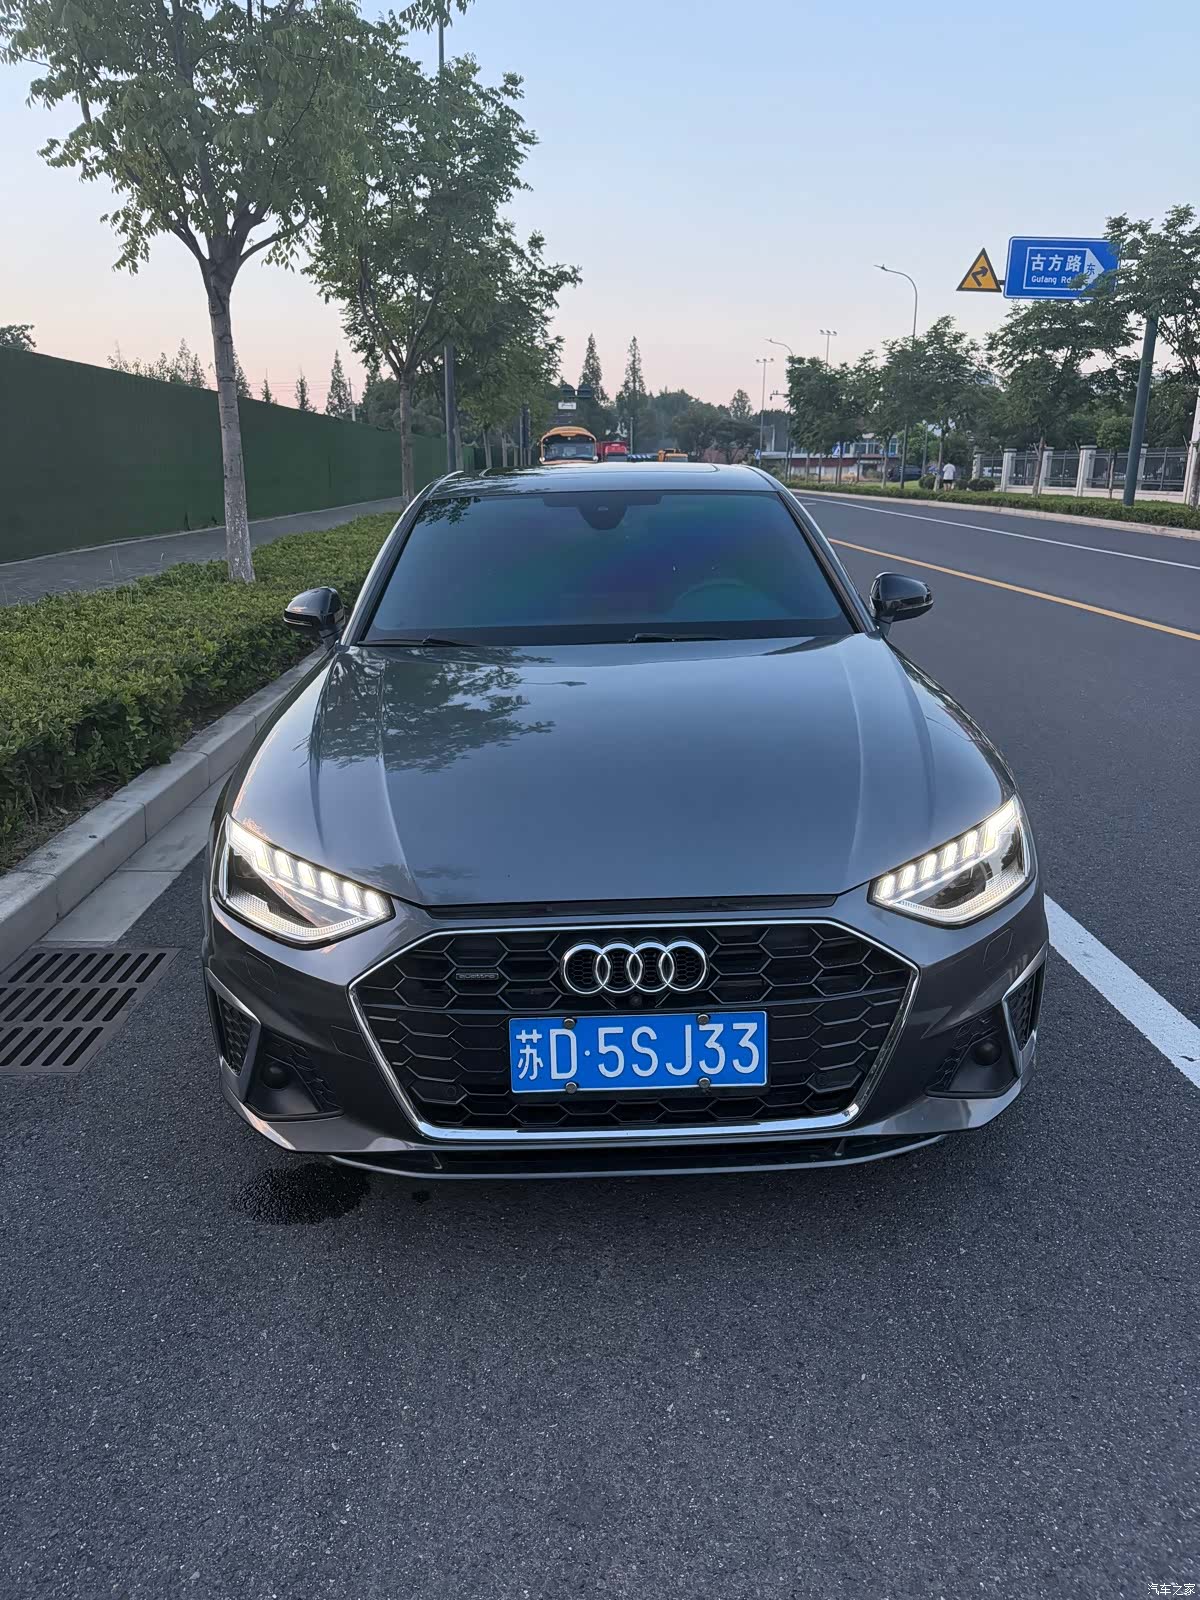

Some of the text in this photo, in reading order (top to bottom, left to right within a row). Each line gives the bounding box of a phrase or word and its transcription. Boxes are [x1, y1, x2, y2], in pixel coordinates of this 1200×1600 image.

[1031, 254, 1082, 272] 古方路
[1087, 263, 1096, 275] 东
[1031, 276, 1057, 285] Gufang
